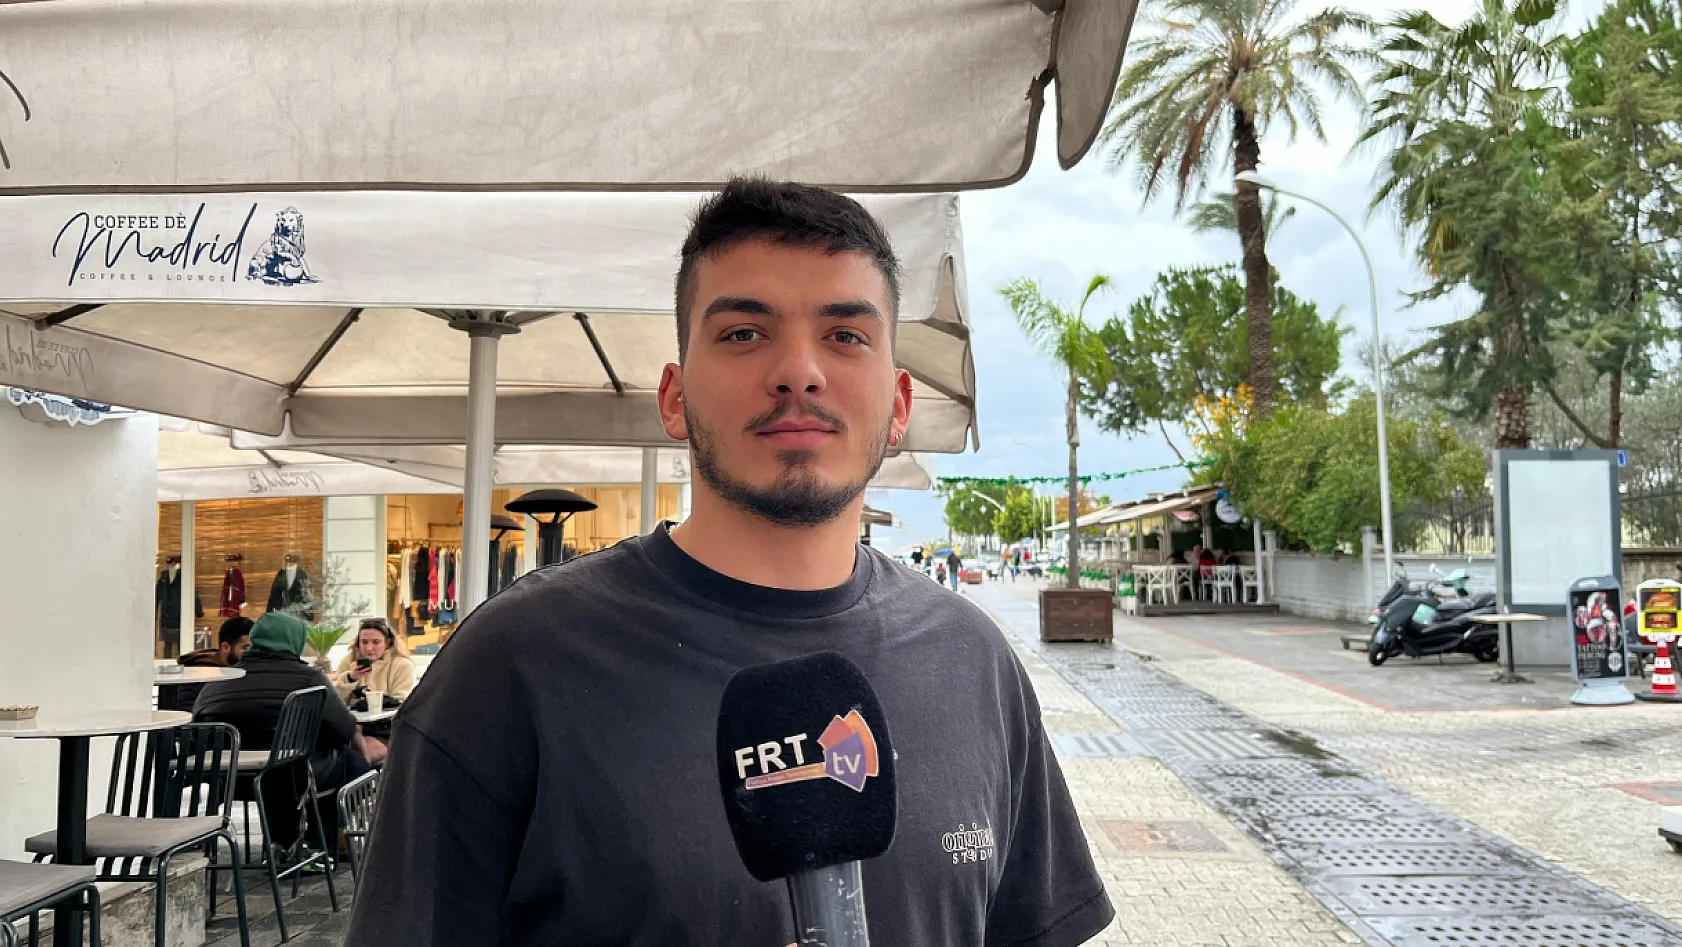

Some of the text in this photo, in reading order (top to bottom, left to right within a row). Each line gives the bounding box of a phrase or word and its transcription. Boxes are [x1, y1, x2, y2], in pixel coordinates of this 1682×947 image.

[94, 212, 187, 229] COFFEE DÈ
[53, 203, 258, 287] Madrid
[79, 272, 137, 281] COFFEE
[166, 273, 225, 283] LOUNGE
[734, 733, 808, 779] FRT
[832, 751, 861, 776] tv
